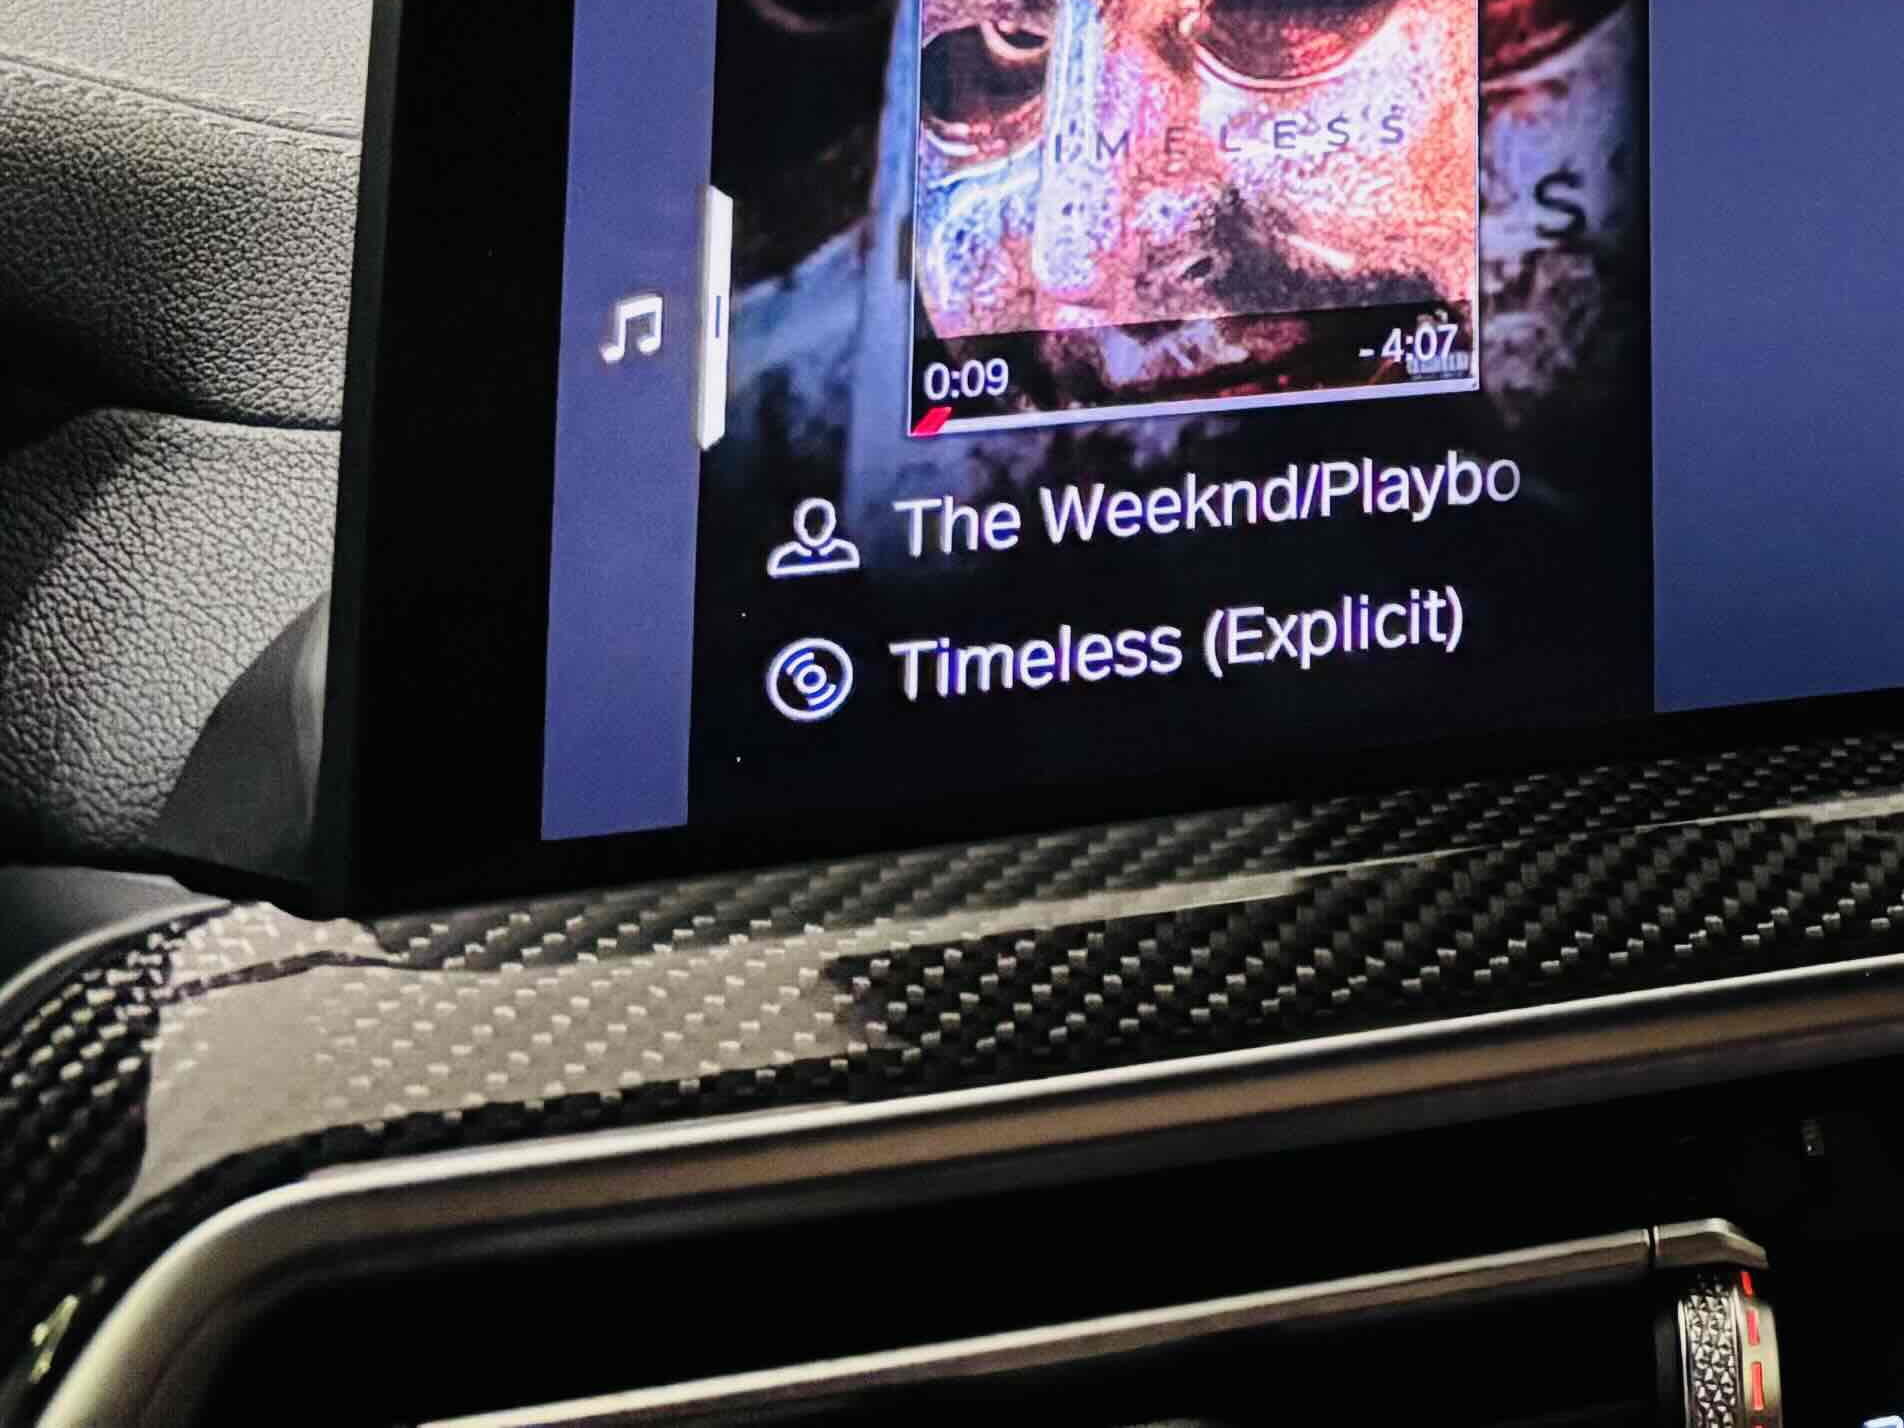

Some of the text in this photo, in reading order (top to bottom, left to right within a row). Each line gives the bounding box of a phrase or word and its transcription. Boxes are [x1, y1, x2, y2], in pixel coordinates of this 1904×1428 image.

[1535, 170, 1589, 240] S
[922, 358, 1010, 400] 0:09
[892, 449, 1522, 558] The Weeknd/Playbo
[889, 584, 1465, 701] Timeless (Explicit)
